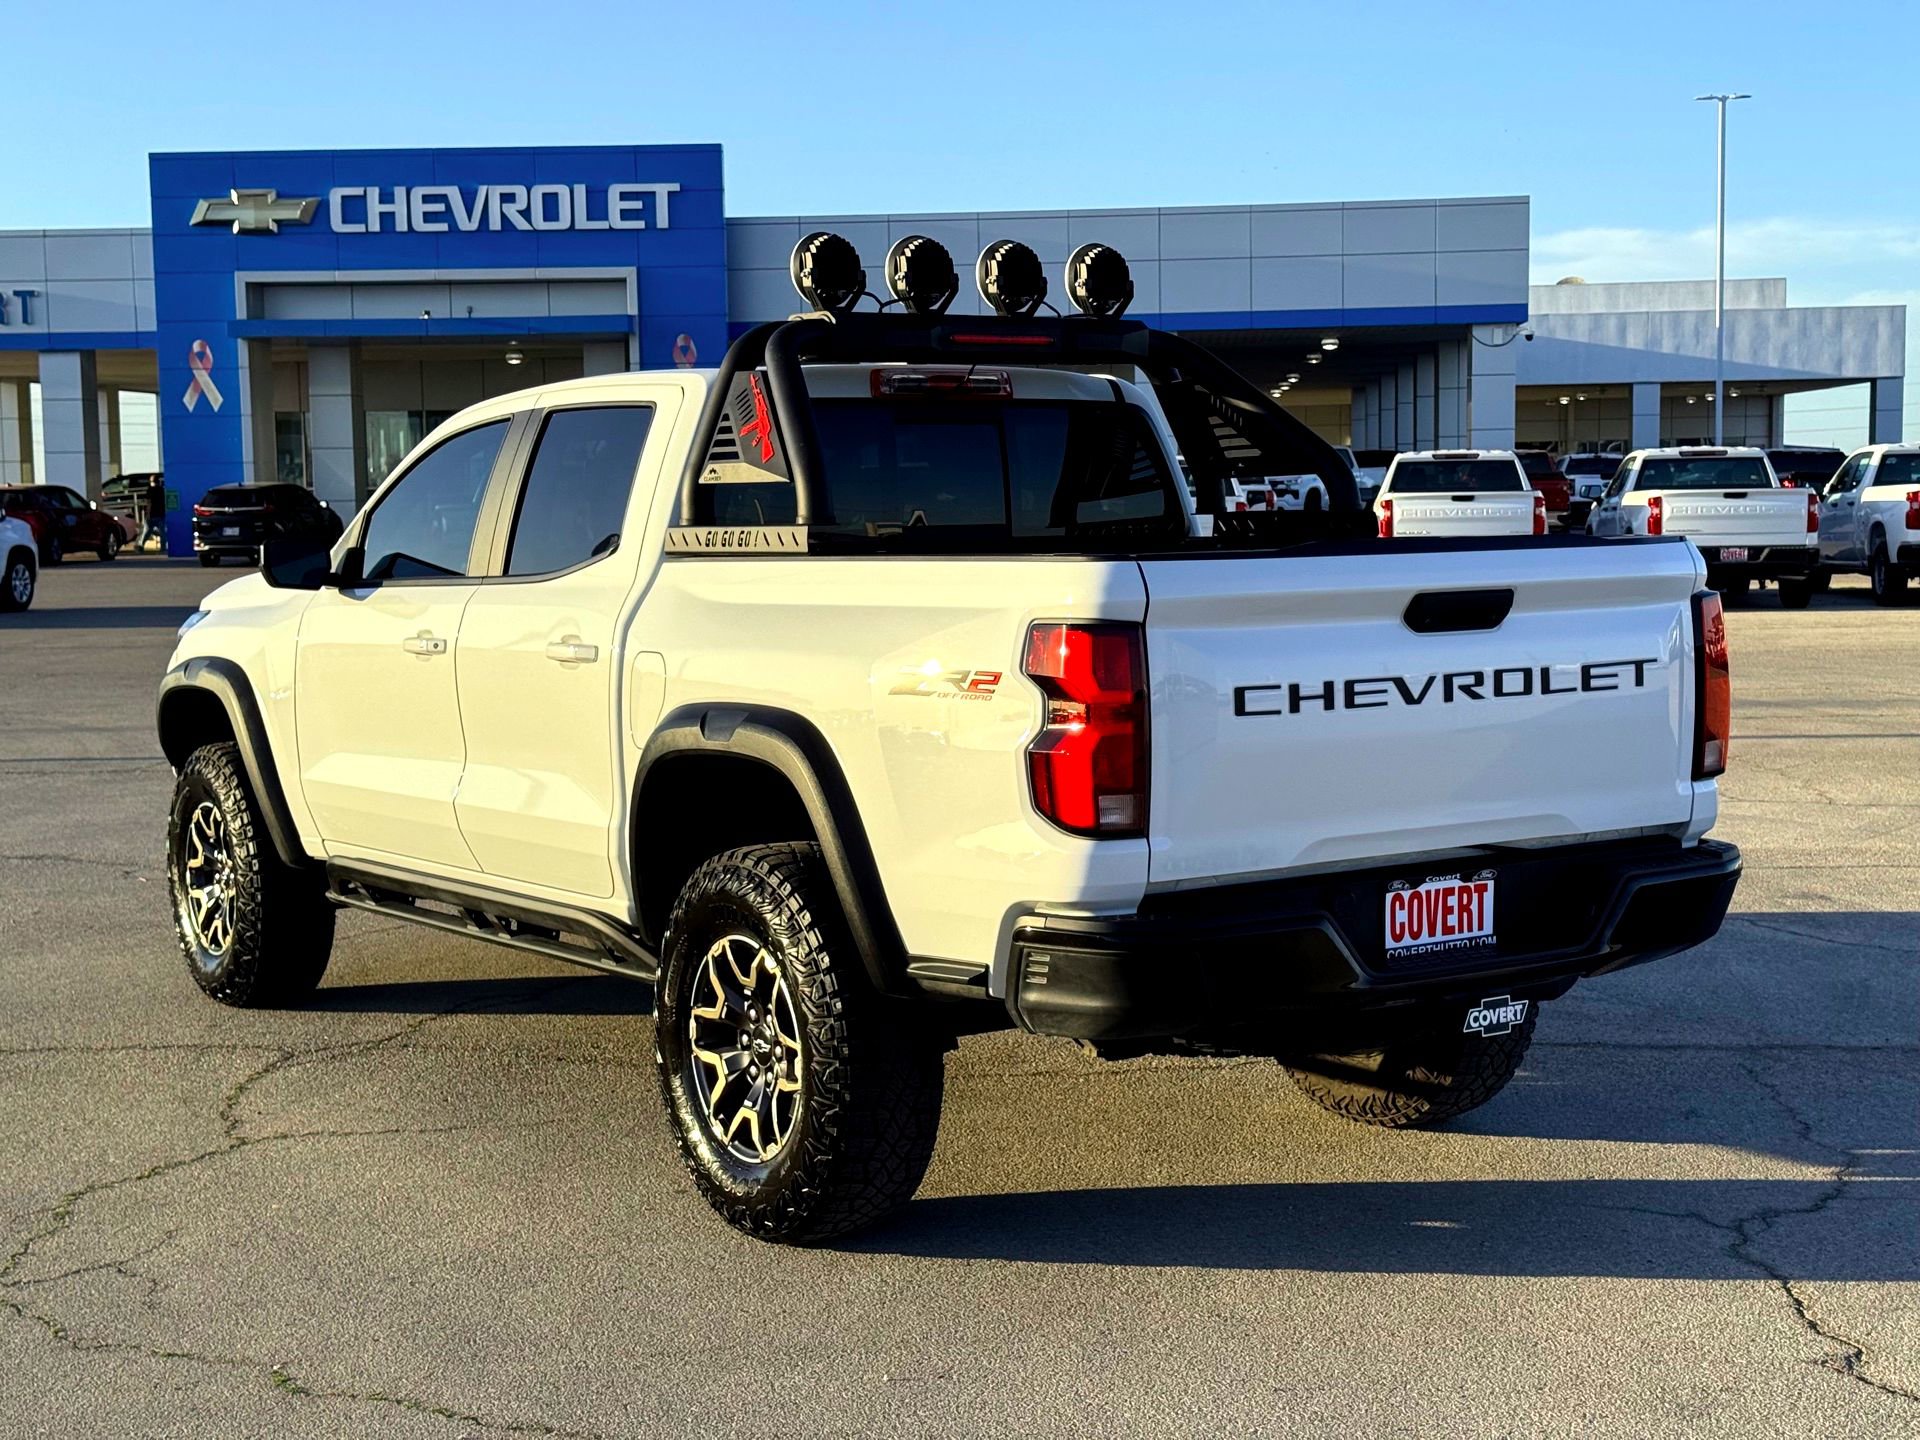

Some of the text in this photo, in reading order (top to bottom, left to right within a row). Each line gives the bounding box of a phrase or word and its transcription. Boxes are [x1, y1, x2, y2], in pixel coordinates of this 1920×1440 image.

[329, 182, 681, 233] CHEVROLET
[705, 530, 719, 548] GO
[721, 530, 735, 548] GO
[937, 691, 993, 702] OFF ROAD
[1233, 657, 1658, 717] CHEVROLET
[1425, 873, 1461, 883] Covert
[1390, 882, 1489, 944] COVERT
[1469, 1004, 1523, 1028] COVERT
